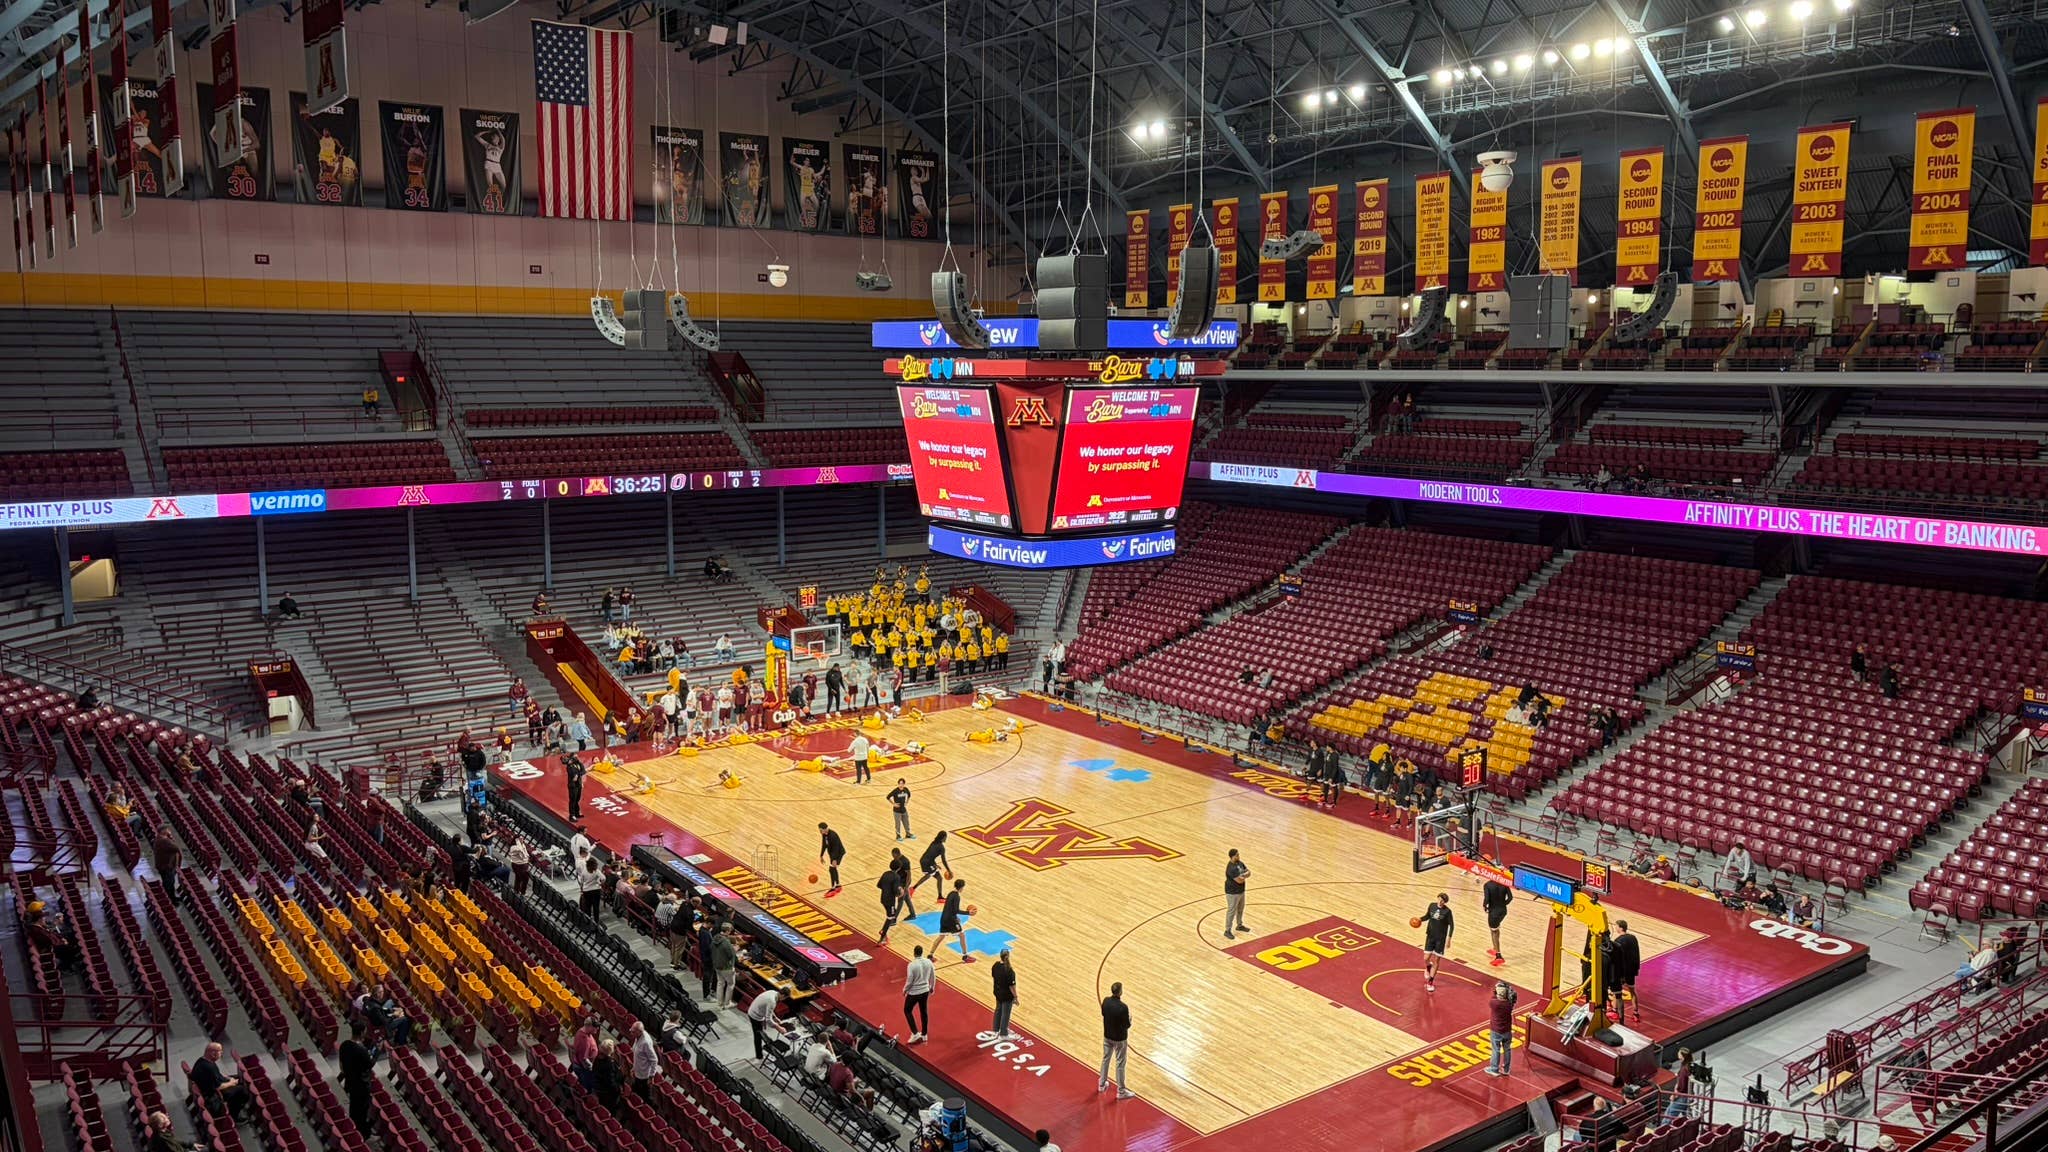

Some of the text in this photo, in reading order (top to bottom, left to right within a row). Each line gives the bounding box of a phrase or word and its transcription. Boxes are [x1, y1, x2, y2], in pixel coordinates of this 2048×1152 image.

[394, 112, 430, 123] BURTON
[475, 120, 506, 130] SKOOG
[656, 135, 698, 146] THOMPSON
[1932, 133, 1959, 143] NCAA
[730, 141, 760, 152] McHALE
[1811, 146, 1836, 156] NCAA
[852, 153, 880, 163] BREWER
[901, 158, 935, 168] GARMAKER
[1712, 159, 1734, 167] NCAA
[1927, 154, 1961, 167] FINAL
[1632, 169, 1652, 177] NCAA
[1803, 166, 1840, 179] SWEET
[1927, 167, 1959, 181] FOUR
[228, 176, 256, 198] 30
[1420, 182, 1445, 196] AIAW
[1702, 177, 1740, 190] SECOND
[1798, 179, 1843, 192] SIXTEEN
[316, 183, 342, 202] 32
[404, 188, 430, 208] 34
[1544, 190, 1577, 200] TOURNAMENT
[1623, 186, 1658, 199] SECOND
[1704, 189, 1737, 201] ROUND
[482, 194, 505, 213] 41
[1625, 198, 1655, 210] ROUND
[1920, 194, 1961, 210] 2004
[1358, 211, 1385, 221] SECOND
[1473, 205, 1505, 214] CHAMPIONS
[1800, 204, 1837, 220] 2003
[858, 216, 876, 234] 52
[1314, 217, 1332, 227] THIRD
[1360, 221, 1382, 231] ROUND
[1703, 213, 1735, 228] 2002
[910, 220, 929, 239] 53
[1475, 227, 1501, 241] 1982
[1624, 221, 1654, 235] 1994
[1359, 240, 1381, 252] 2019
[903, 354, 928, 381] Barn
[955, 362, 973, 376] MN
[1088, 354, 1143, 384] THE Barn
[1178, 361, 1195, 375] MN
[925, 389, 951, 400] WELCOME
[1112, 390, 1160, 401] WELCOME TO
[914, 395, 939, 419] Barn
[1087, 399, 1123, 423] Barn
[1169, 405, 1182, 414] MN
[919, 440, 987, 458] We honor our legacy
[1080, 444, 1174, 457] We honor our legacy
[929, 456, 938, 467] by
[938, 458, 974, 472] surpassing
[1088, 458, 1161, 474] by surpassing it.
[1220, 465, 1279, 479] AFFINITY PLUS
[558, 481, 569, 495] 0
[614, 476, 661, 494] 36:25
[703, 474, 713, 488] 0
[732, 478, 740, 488] 0
[752, 477, 760, 487] 2
[503, 487, 535, 500] 2 0
[1419, 483, 1503, 504] MODERN TOOLS.
[72, 501, 114, 516] PLUS
[250, 492, 324, 511] venmo
[1131, 512, 1158, 521] MAVERICKS
[1684, 502, 2042, 552] AFFINITY PLUS. THE HEART OF BANKING.
[983, 540, 1048, 564] Fairview
[800, 587, 817, 596] 36:25
[802, 595, 815, 607] 30
[772, 710, 796, 724] Cub
[1463, 752, 1482, 766] 36:25
[1464, 765, 1480, 785] 30
[667, 860, 713, 885] TOYOTA
[1585, 863, 1606, 876] 36:25
[1587, 874, 1602, 886] 30
[1547, 883, 1562, 896] MN
[711, 865, 854, 944] MINNESOTA
[753, 914, 807, 945] TOYOTA
[1749, 917, 1854, 956] Cub
